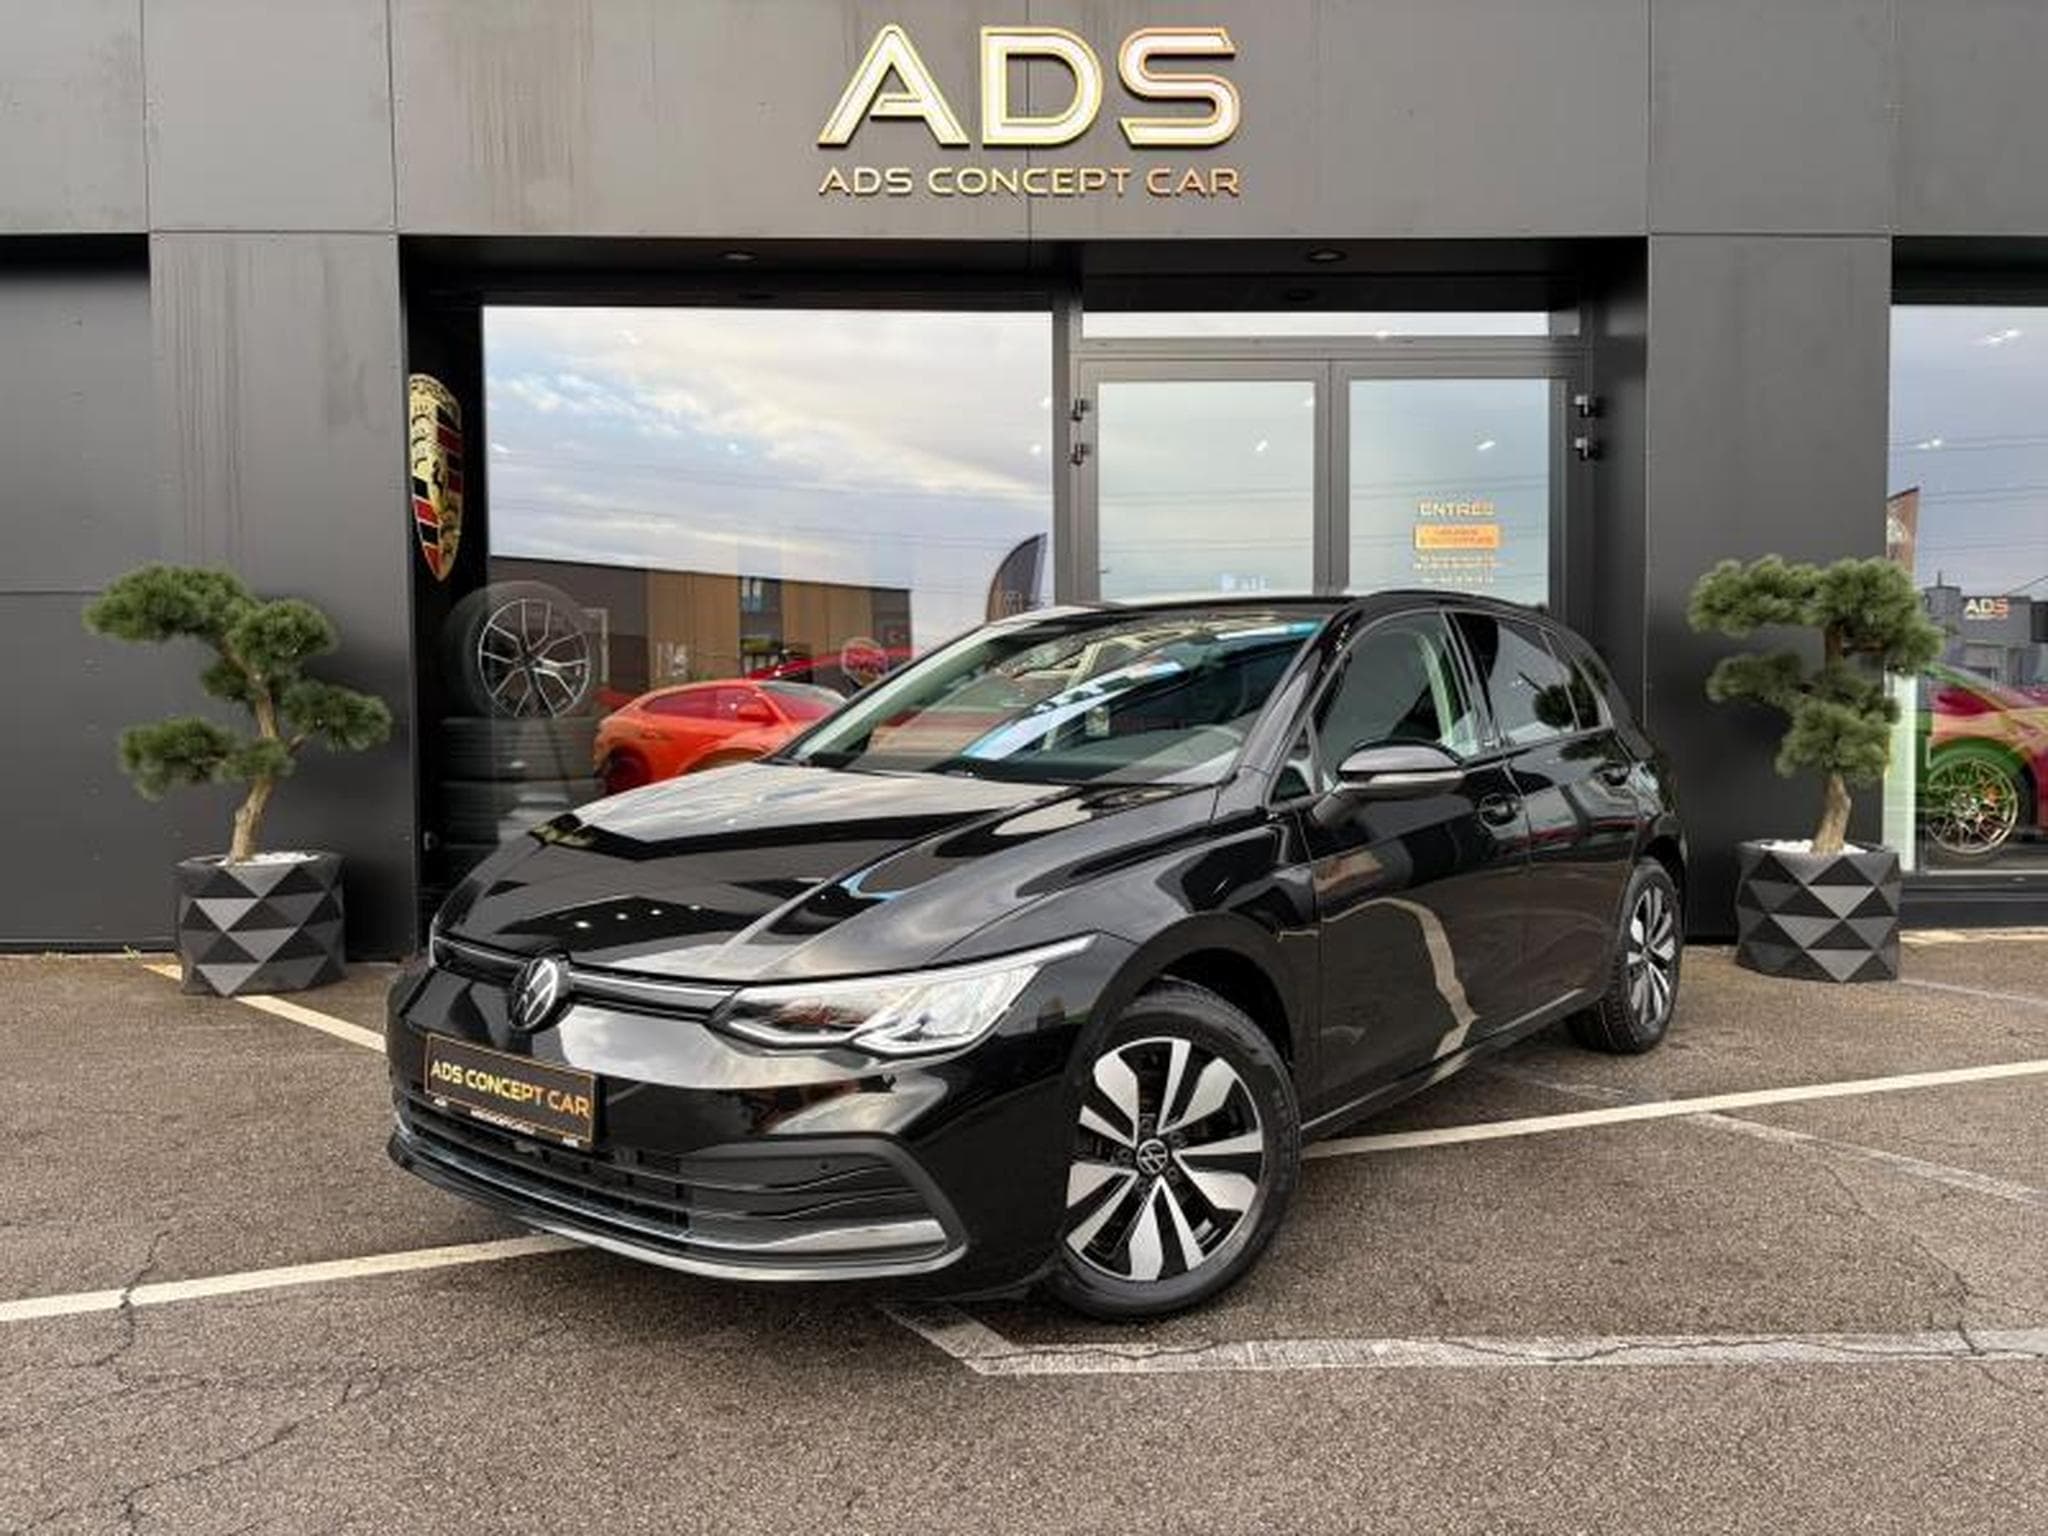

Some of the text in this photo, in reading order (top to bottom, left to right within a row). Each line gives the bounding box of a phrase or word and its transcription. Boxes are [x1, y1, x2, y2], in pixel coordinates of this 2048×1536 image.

[817, 23, 1241, 147] ADS
[819, 167, 1241, 196] ADS CONCEPT CAR
[1964, 598, 2009, 614] ADS
[430, 1060, 592, 1118] ADS CONCEPT CAR
